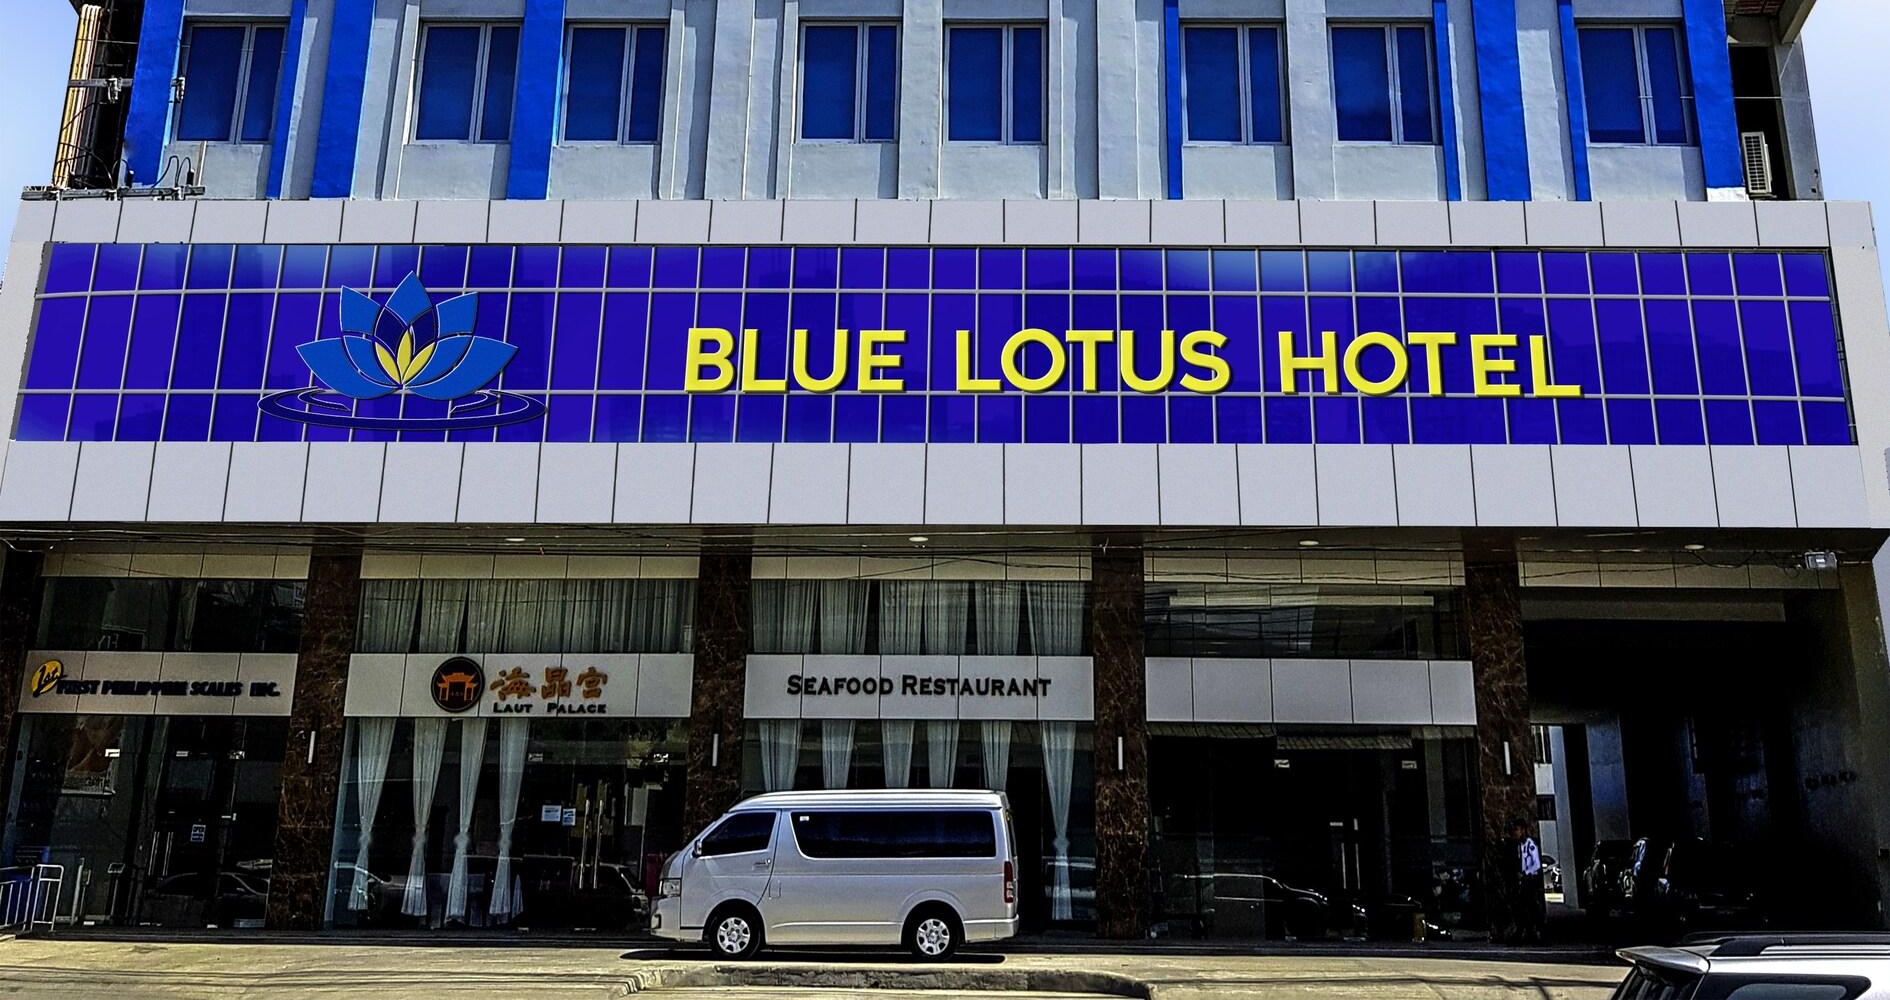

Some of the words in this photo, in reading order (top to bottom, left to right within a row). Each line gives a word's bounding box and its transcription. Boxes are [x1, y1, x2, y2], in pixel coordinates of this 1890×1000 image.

[685, 327, 905, 395] BLUE
[956, 328, 1230, 395] LOTUS
[1279, 331, 1582, 398] HOTEL
[56, 680, 100, 695] FIRST
[787, 674, 894, 696] SEAFOOD
[901, 674, 1051, 697] RESTAURANT
[493, 702, 533, 714] LAUT
[547, 702, 608, 715] PALACE
